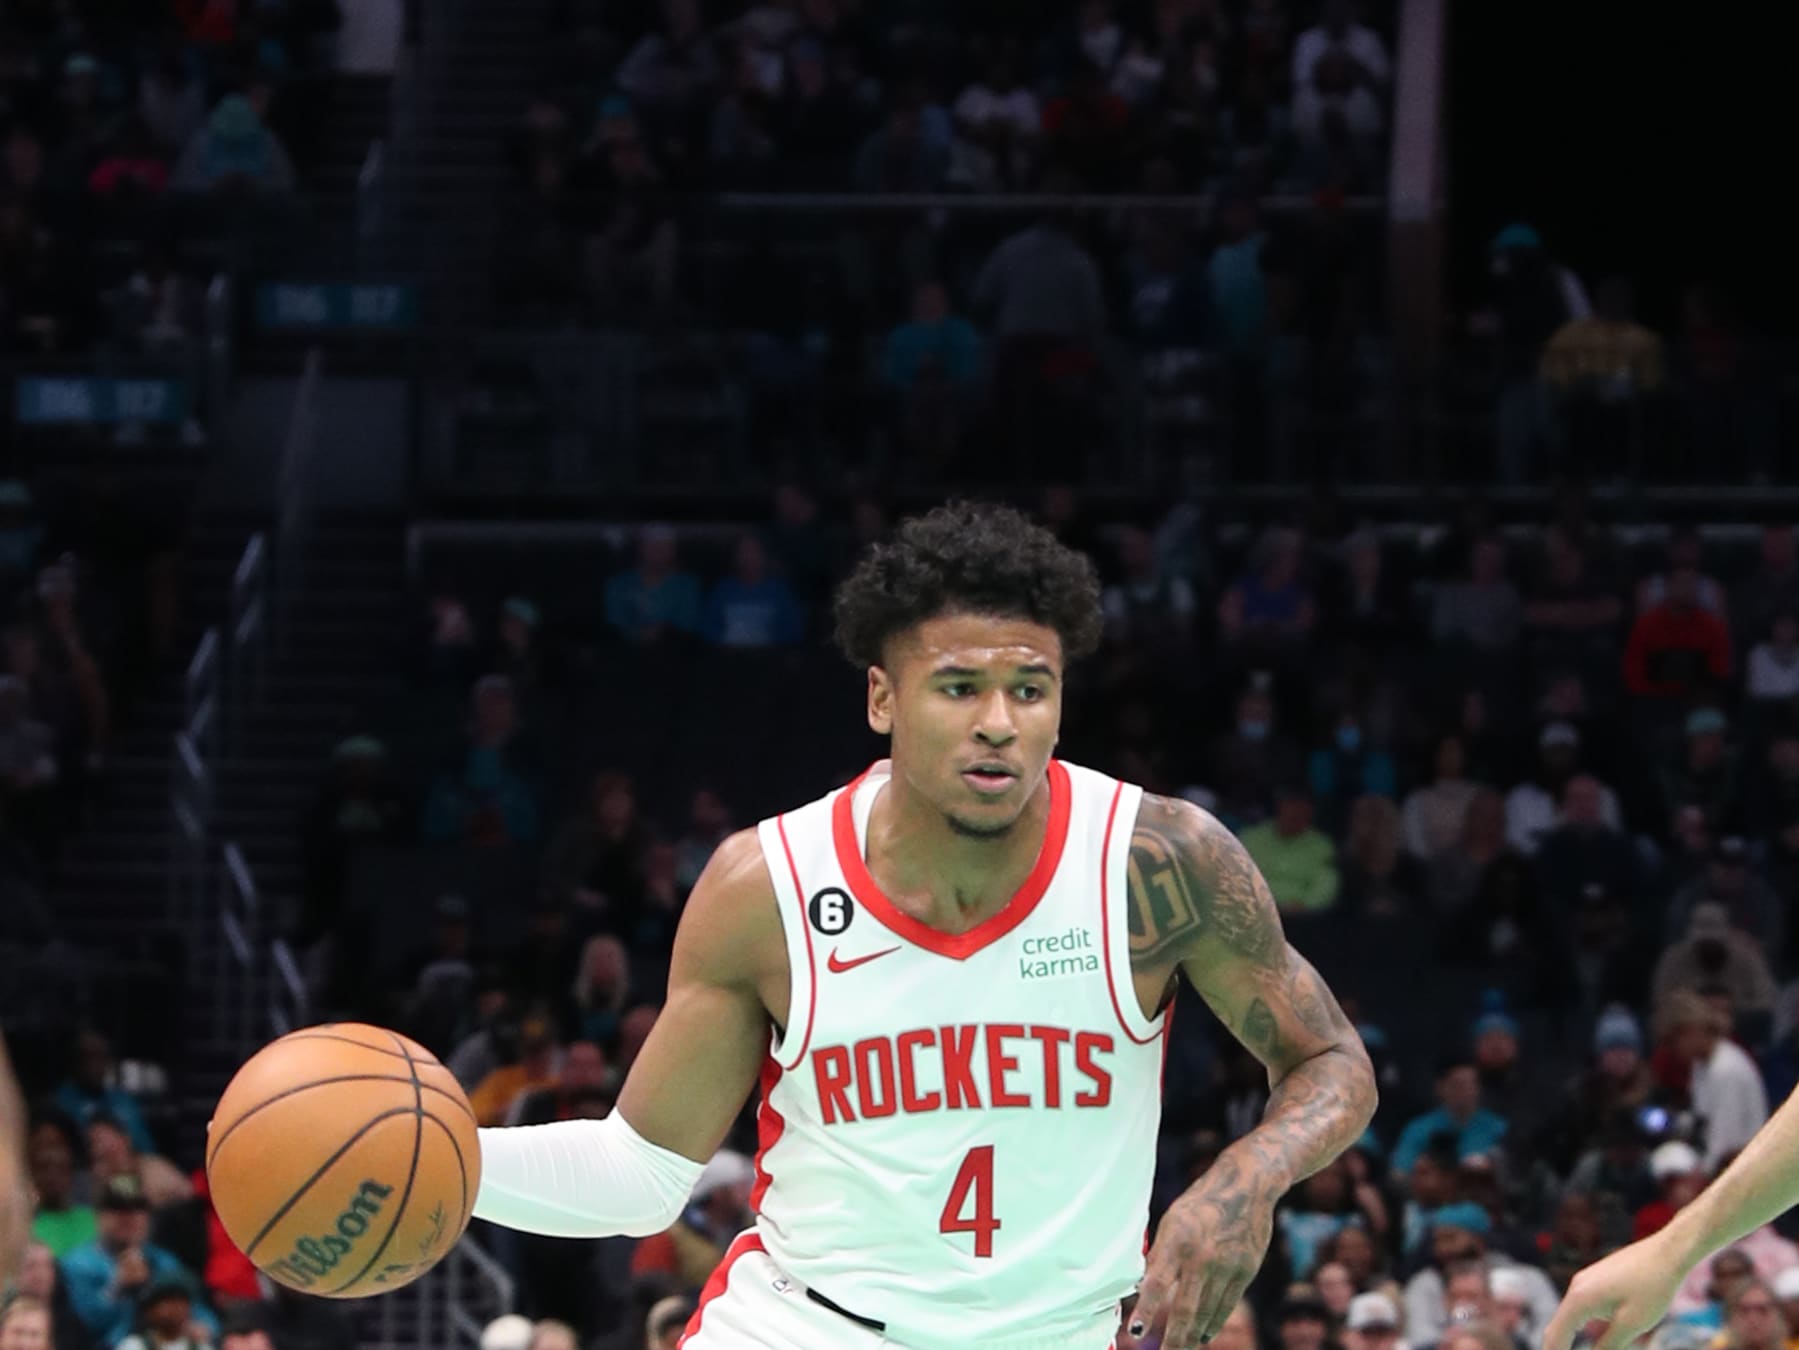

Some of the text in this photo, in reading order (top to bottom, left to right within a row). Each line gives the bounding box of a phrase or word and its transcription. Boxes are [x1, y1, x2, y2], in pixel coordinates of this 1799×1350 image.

[818, 892, 846, 931] 6
[1022, 928, 1093, 955] credit
[1019, 953, 1100, 979] karma
[811, 1024, 1115, 1126] ROCKETS
[939, 1145, 1001, 1258] 4
